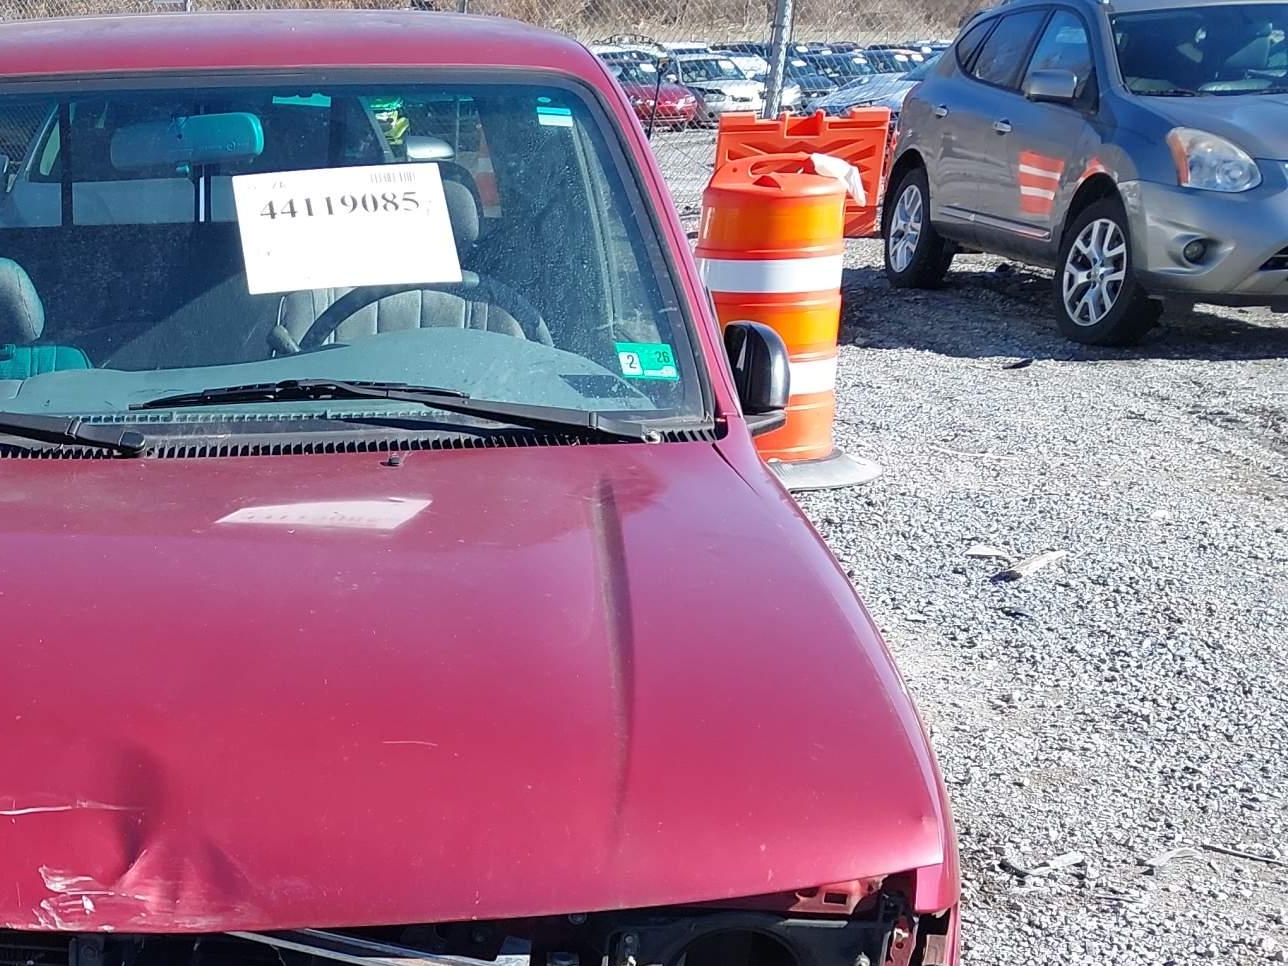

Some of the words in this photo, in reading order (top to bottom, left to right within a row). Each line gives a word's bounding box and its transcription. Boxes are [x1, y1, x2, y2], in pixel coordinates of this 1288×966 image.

[260, 191, 420, 220] 44119085
[626, 354, 637, 369] 2
[655, 350, 671, 363] 26
